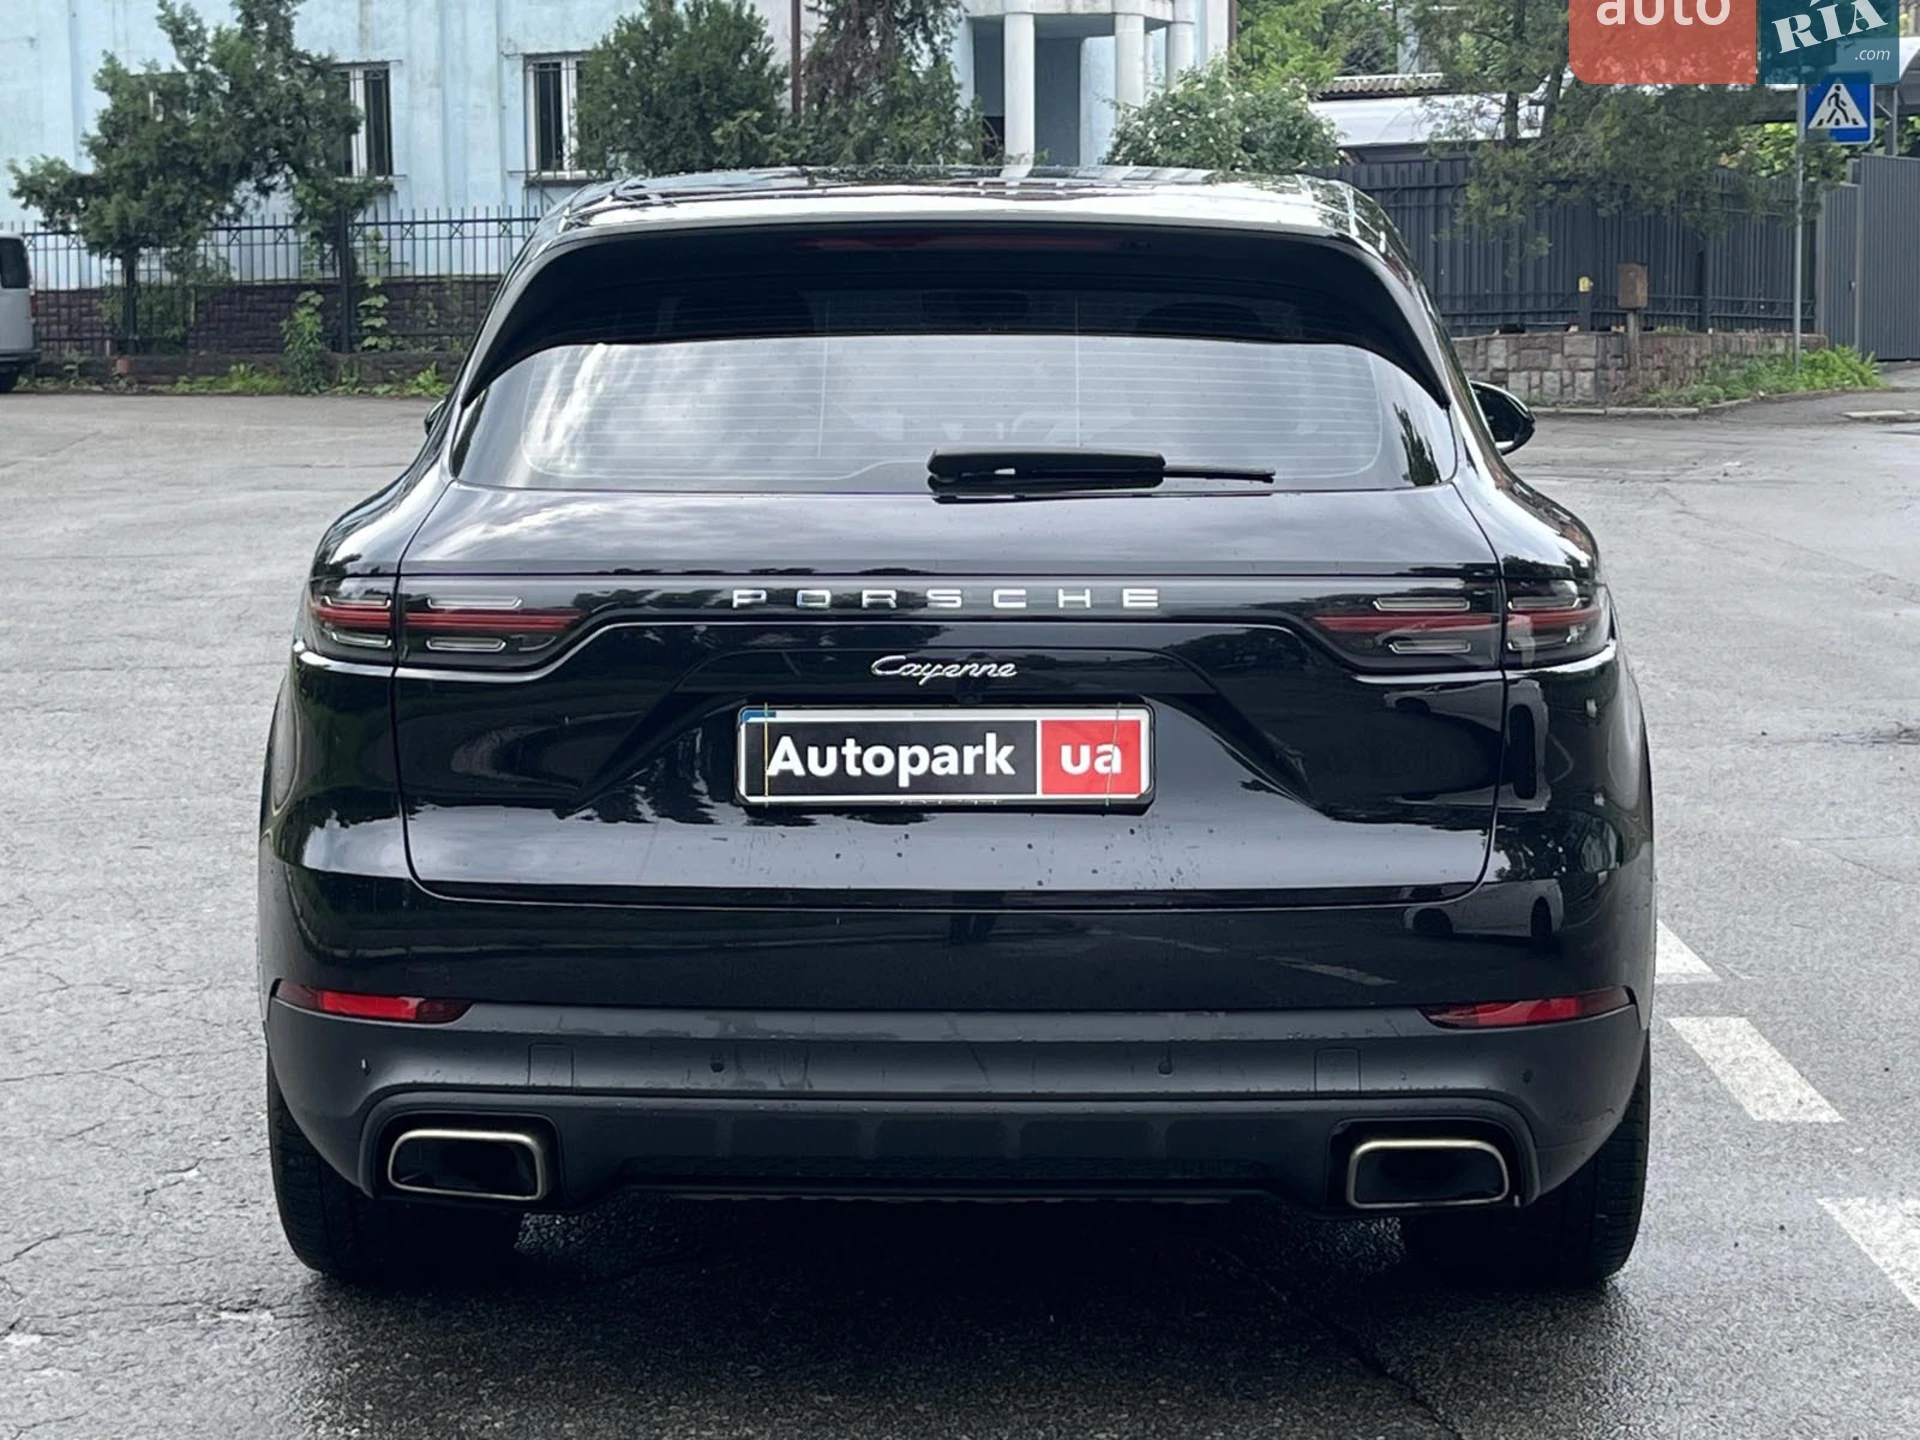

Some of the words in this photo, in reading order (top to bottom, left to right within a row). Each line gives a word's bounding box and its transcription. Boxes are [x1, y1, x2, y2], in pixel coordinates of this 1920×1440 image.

[731, 588, 1160, 609] PORSCHE
[871, 655, 1018, 685] Cayenne
[766, 732, 1016, 788] Autopark
[1060, 742, 1122, 775] ua
